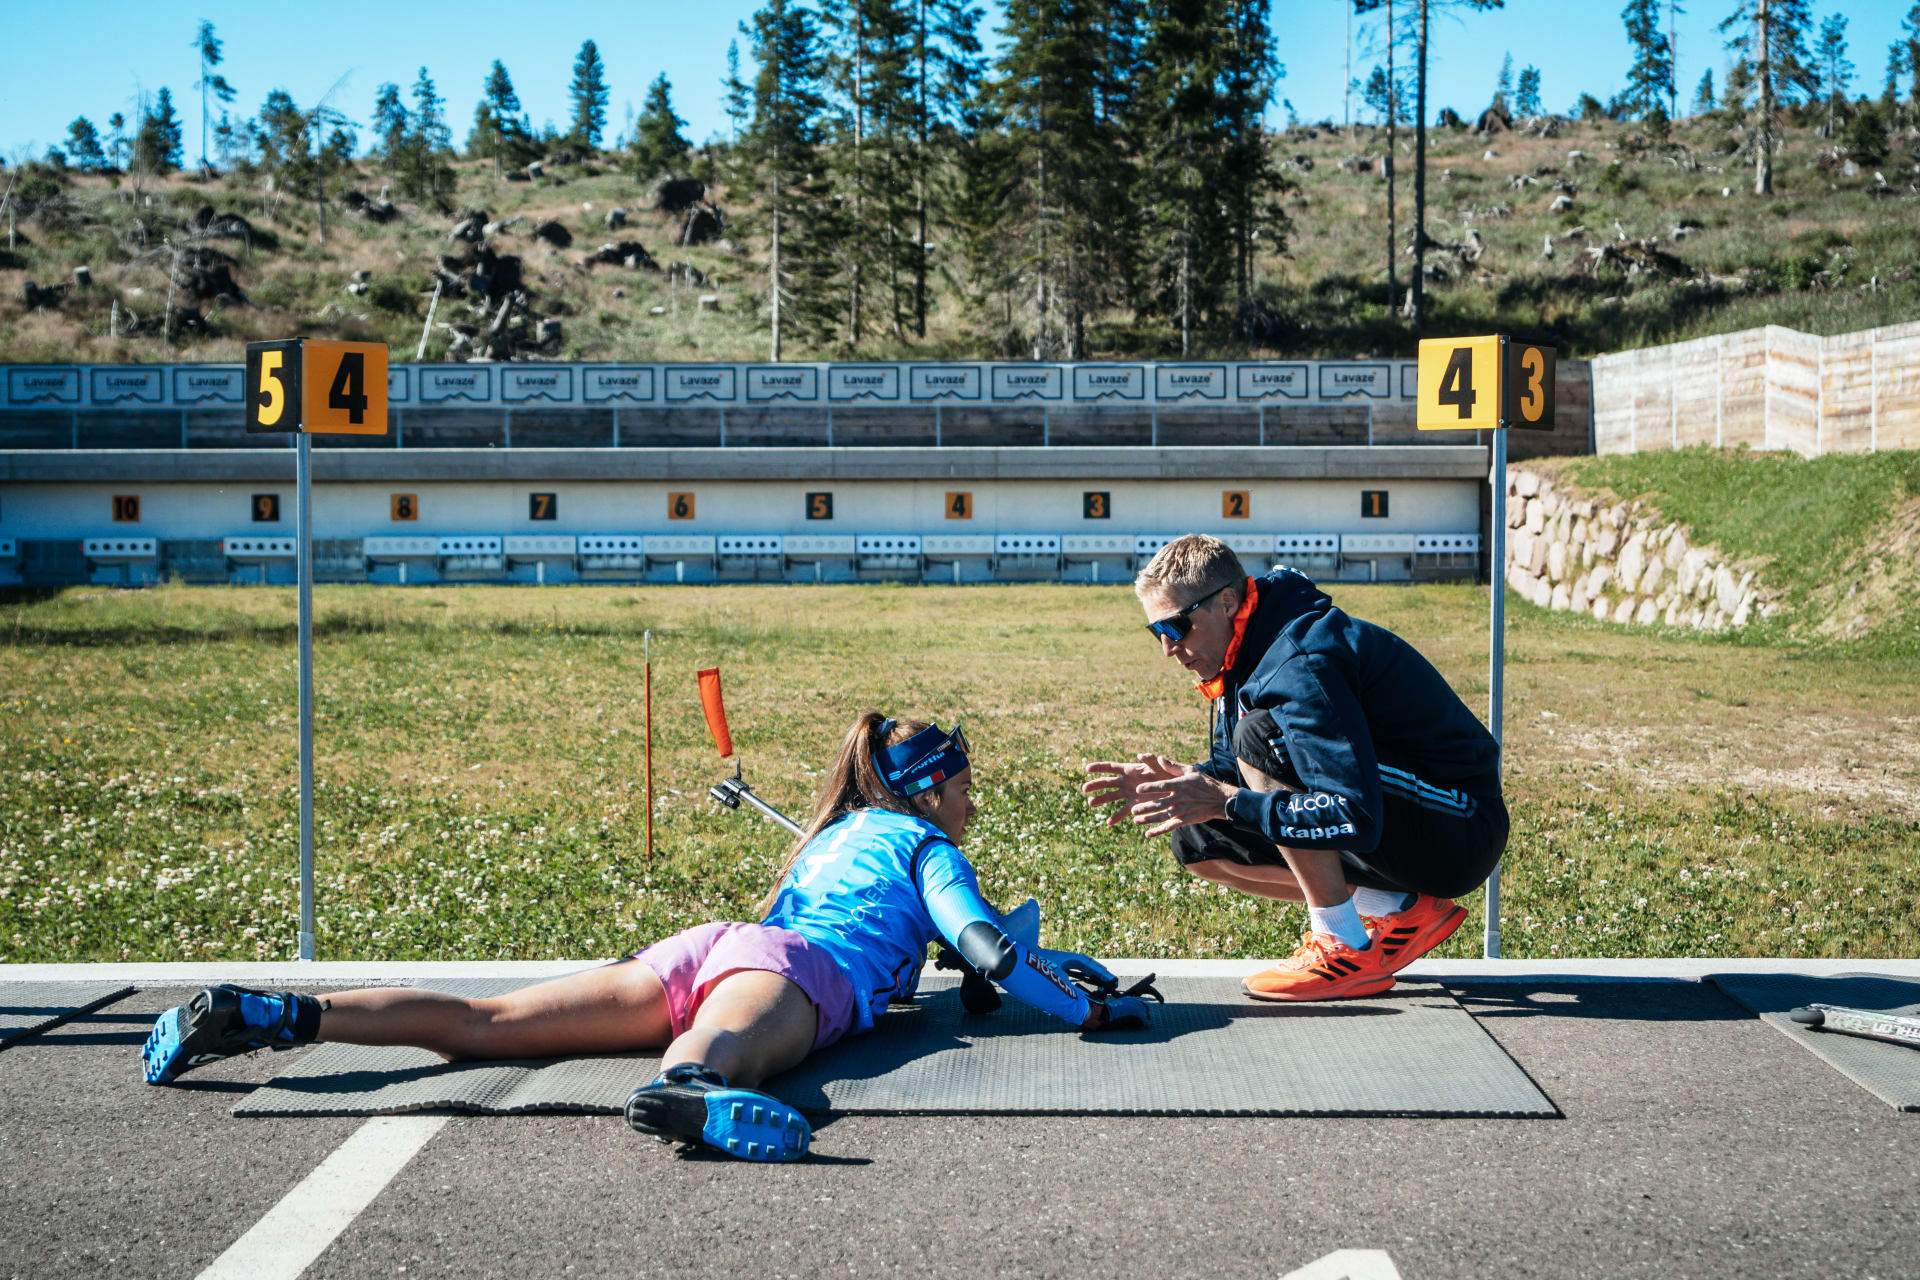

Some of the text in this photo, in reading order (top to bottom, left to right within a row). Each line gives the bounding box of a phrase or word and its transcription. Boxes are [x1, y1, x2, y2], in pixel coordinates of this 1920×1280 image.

[257, 350, 285, 426] 5
[328, 352, 368, 424] 4
[1438, 347, 1476, 419] 4
[1520, 347, 1544, 422] 3
[115, 497, 137, 520] 10
[258, 497, 273, 520] 9
[397, 496, 411, 519] 8
[535, 495, 550, 518] 7
[674, 495, 688, 517] 6
[812, 495, 827, 518] 5
[952, 494, 966, 517] 4
[1089, 494, 1104, 517] 3
[1229, 493, 1243, 516] 2
[1371, 493, 1380, 516] 1
[1280, 823, 1353, 840] Kappa
